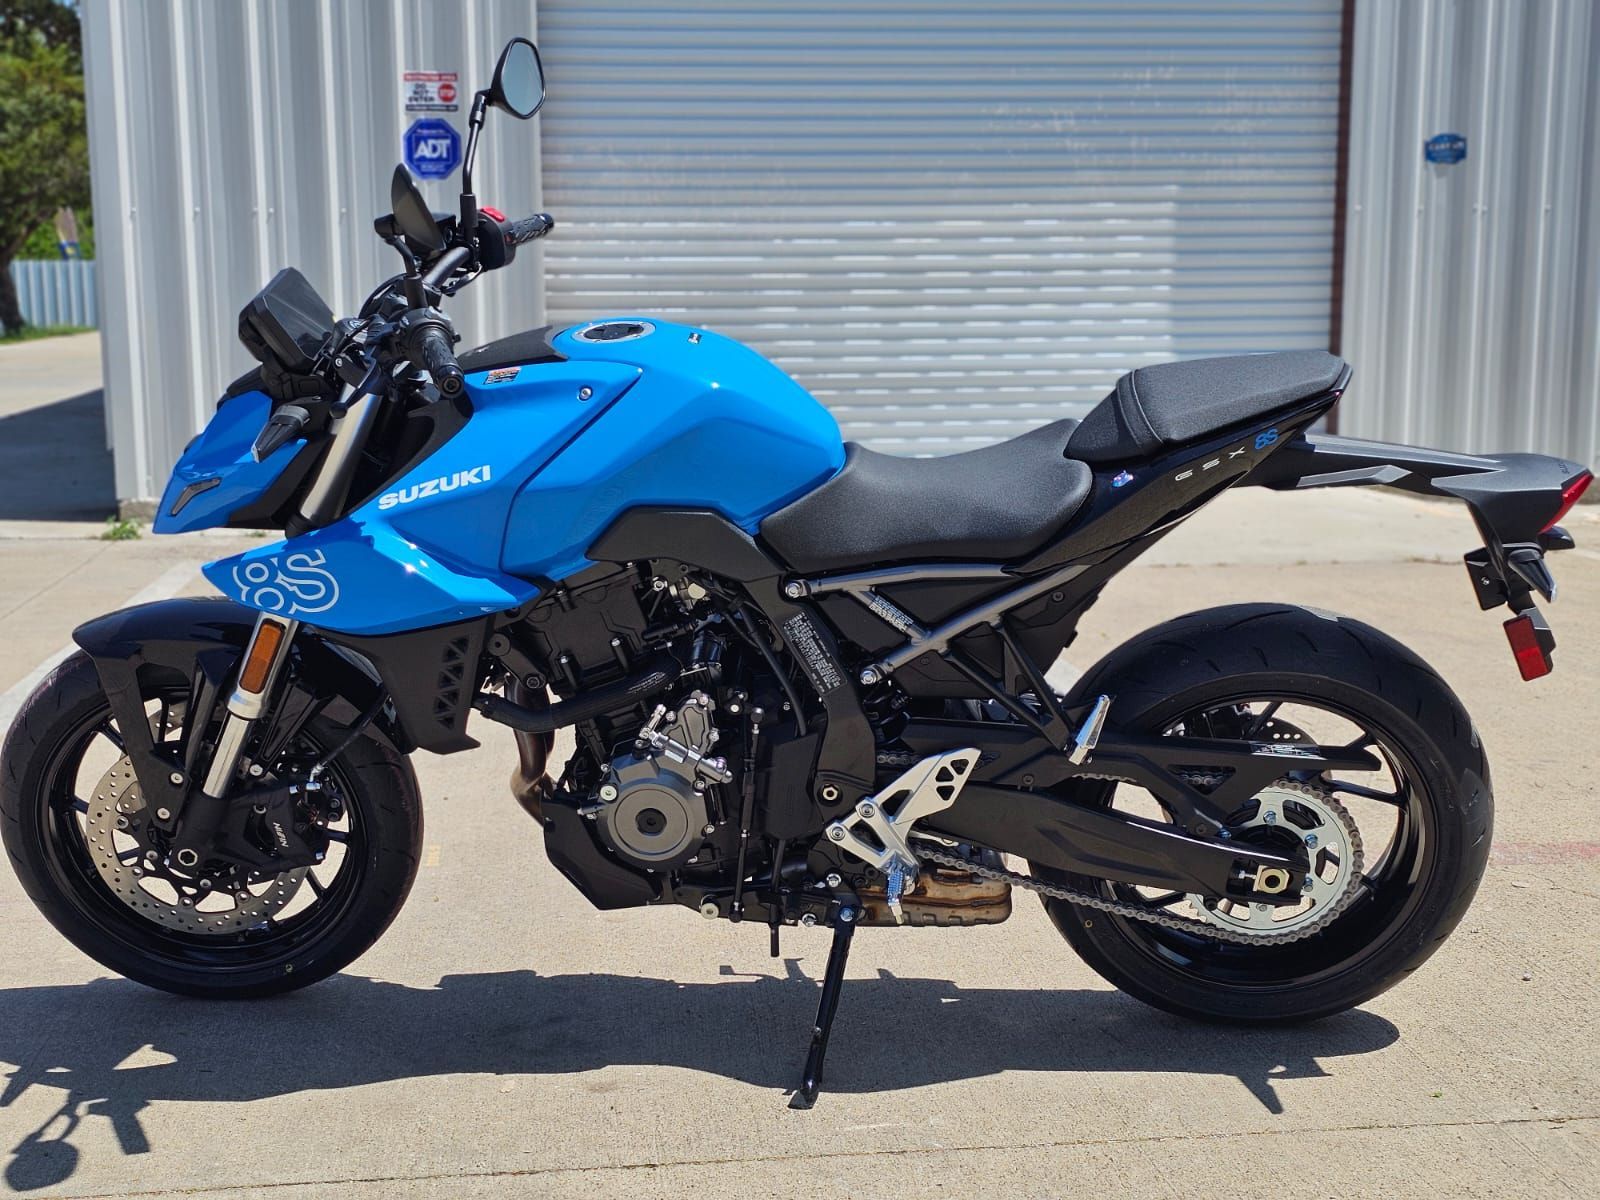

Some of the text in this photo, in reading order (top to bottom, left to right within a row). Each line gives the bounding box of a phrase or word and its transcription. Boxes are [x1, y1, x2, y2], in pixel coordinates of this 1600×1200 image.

[414, 139, 451, 159] ADT
[378, 465, 491, 510] SUZUKI
[232, 548, 340, 615] 8S
